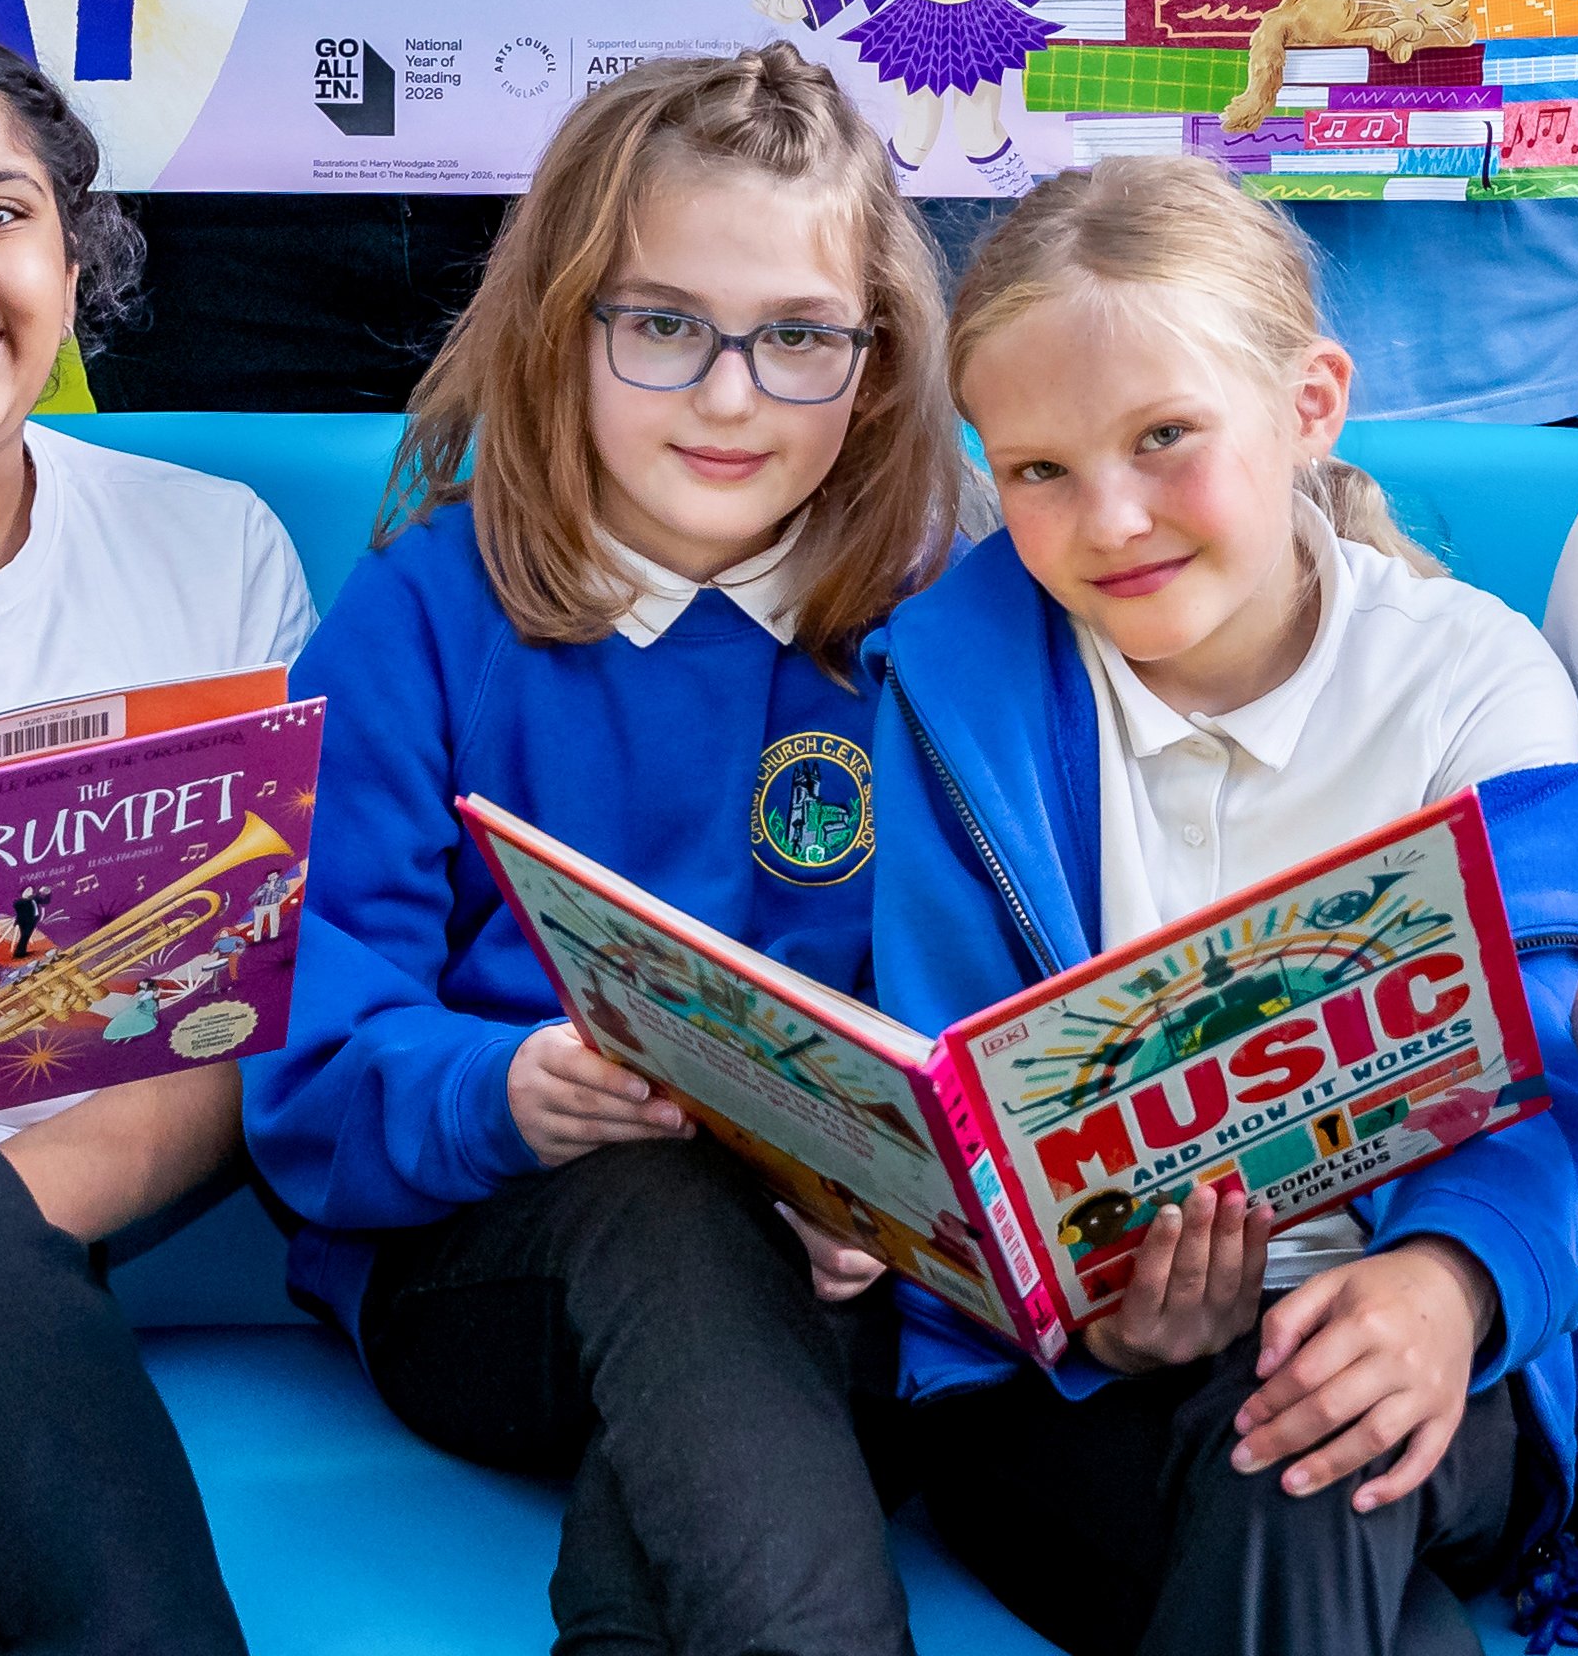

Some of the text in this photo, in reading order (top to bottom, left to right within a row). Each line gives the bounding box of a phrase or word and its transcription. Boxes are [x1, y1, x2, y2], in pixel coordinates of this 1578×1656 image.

[315, 38, 359, 58] GO
[405, 38, 462, 52] National
[587, 38, 637, 50] Supported
[639, 40, 664, 51] using
[694, 38, 729, 51] funding
[406, 54, 455, 67] Year of
[494, 37, 556, 73] ARTS COUNCIL
[314, 59, 359, 79] ALL
[405, 71, 461, 86] Reading
[314, 80, 359, 99] IN.
[405, 87, 444, 100] 2026
[500, 79, 550, 98] ENGLAND
[313, 159, 358, 167] Illustrations
[369, 159, 390, 169] Harry
[392, 159, 433, 169] Woodgate
[313, 170, 331, 179] Read
[332, 171, 341, 179] to
[342, 170, 356, 179] the
[358, 170, 377, 179] Beat
[388, 171, 403, 179] The
[405, 170, 437, 181] Reading
[439, 171, 469, 181] Agency
[757, 737, 818, 782] CHURCH
[77, 779, 114, 803] THE
[986, 1027, 1022, 1055] DK
[1034, 951, 1470, 1203] MUSIC
[1132, 1017, 1473, 1188] AND HOW IT WORKS
[1265, 1135, 1390, 1201] COMPLETE
[1290, 1149, 1392, 1209] FOR KIDS
